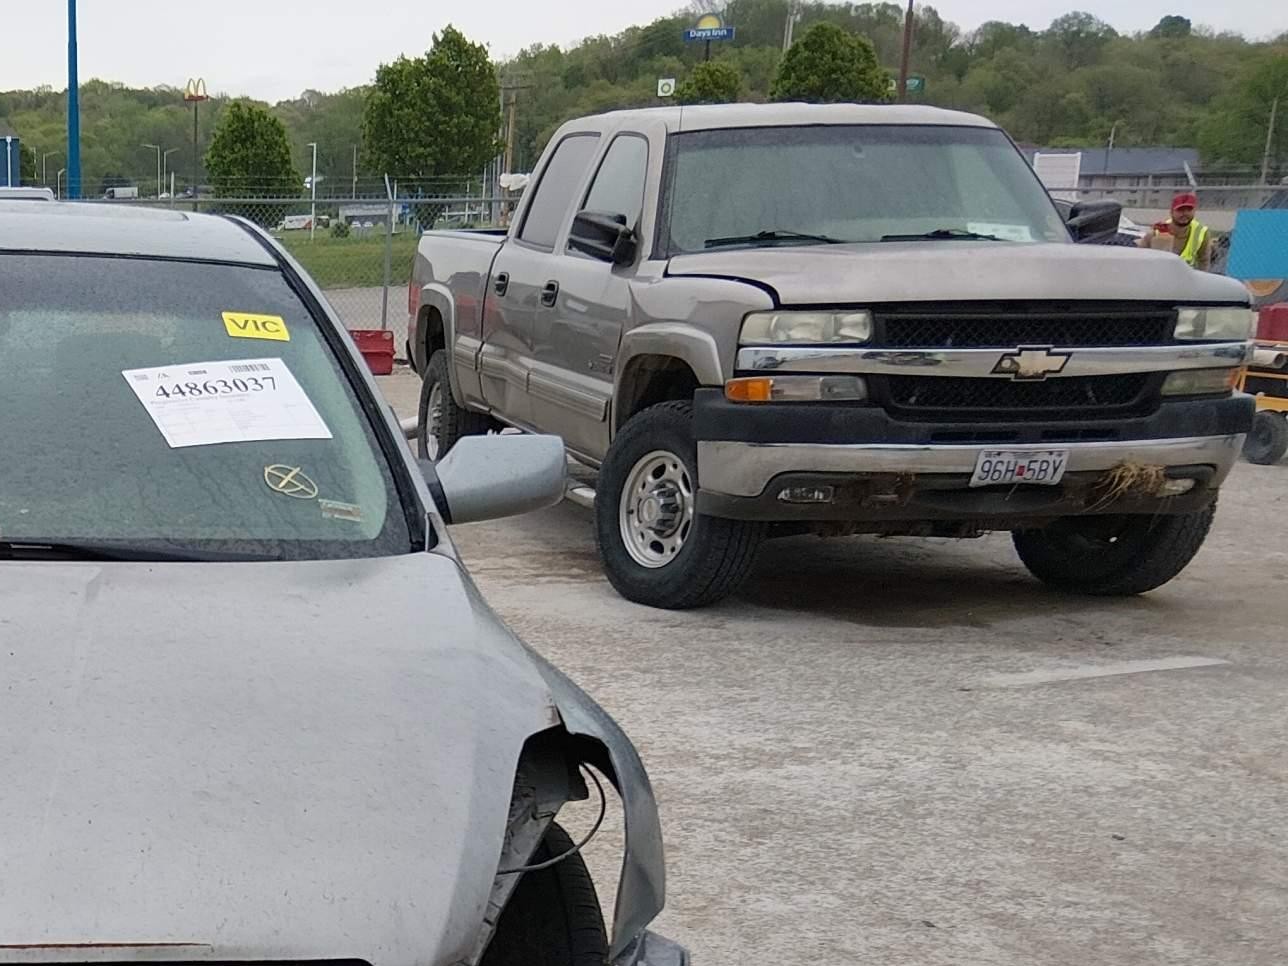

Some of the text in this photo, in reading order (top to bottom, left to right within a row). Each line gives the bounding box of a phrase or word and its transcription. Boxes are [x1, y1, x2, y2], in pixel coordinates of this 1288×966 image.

[689, 28, 727, 38] Days Inn
[228, 318, 281, 333] VIC
[155, 376, 278, 399] 44863037
[978, 460, 1018, 481] 96H
